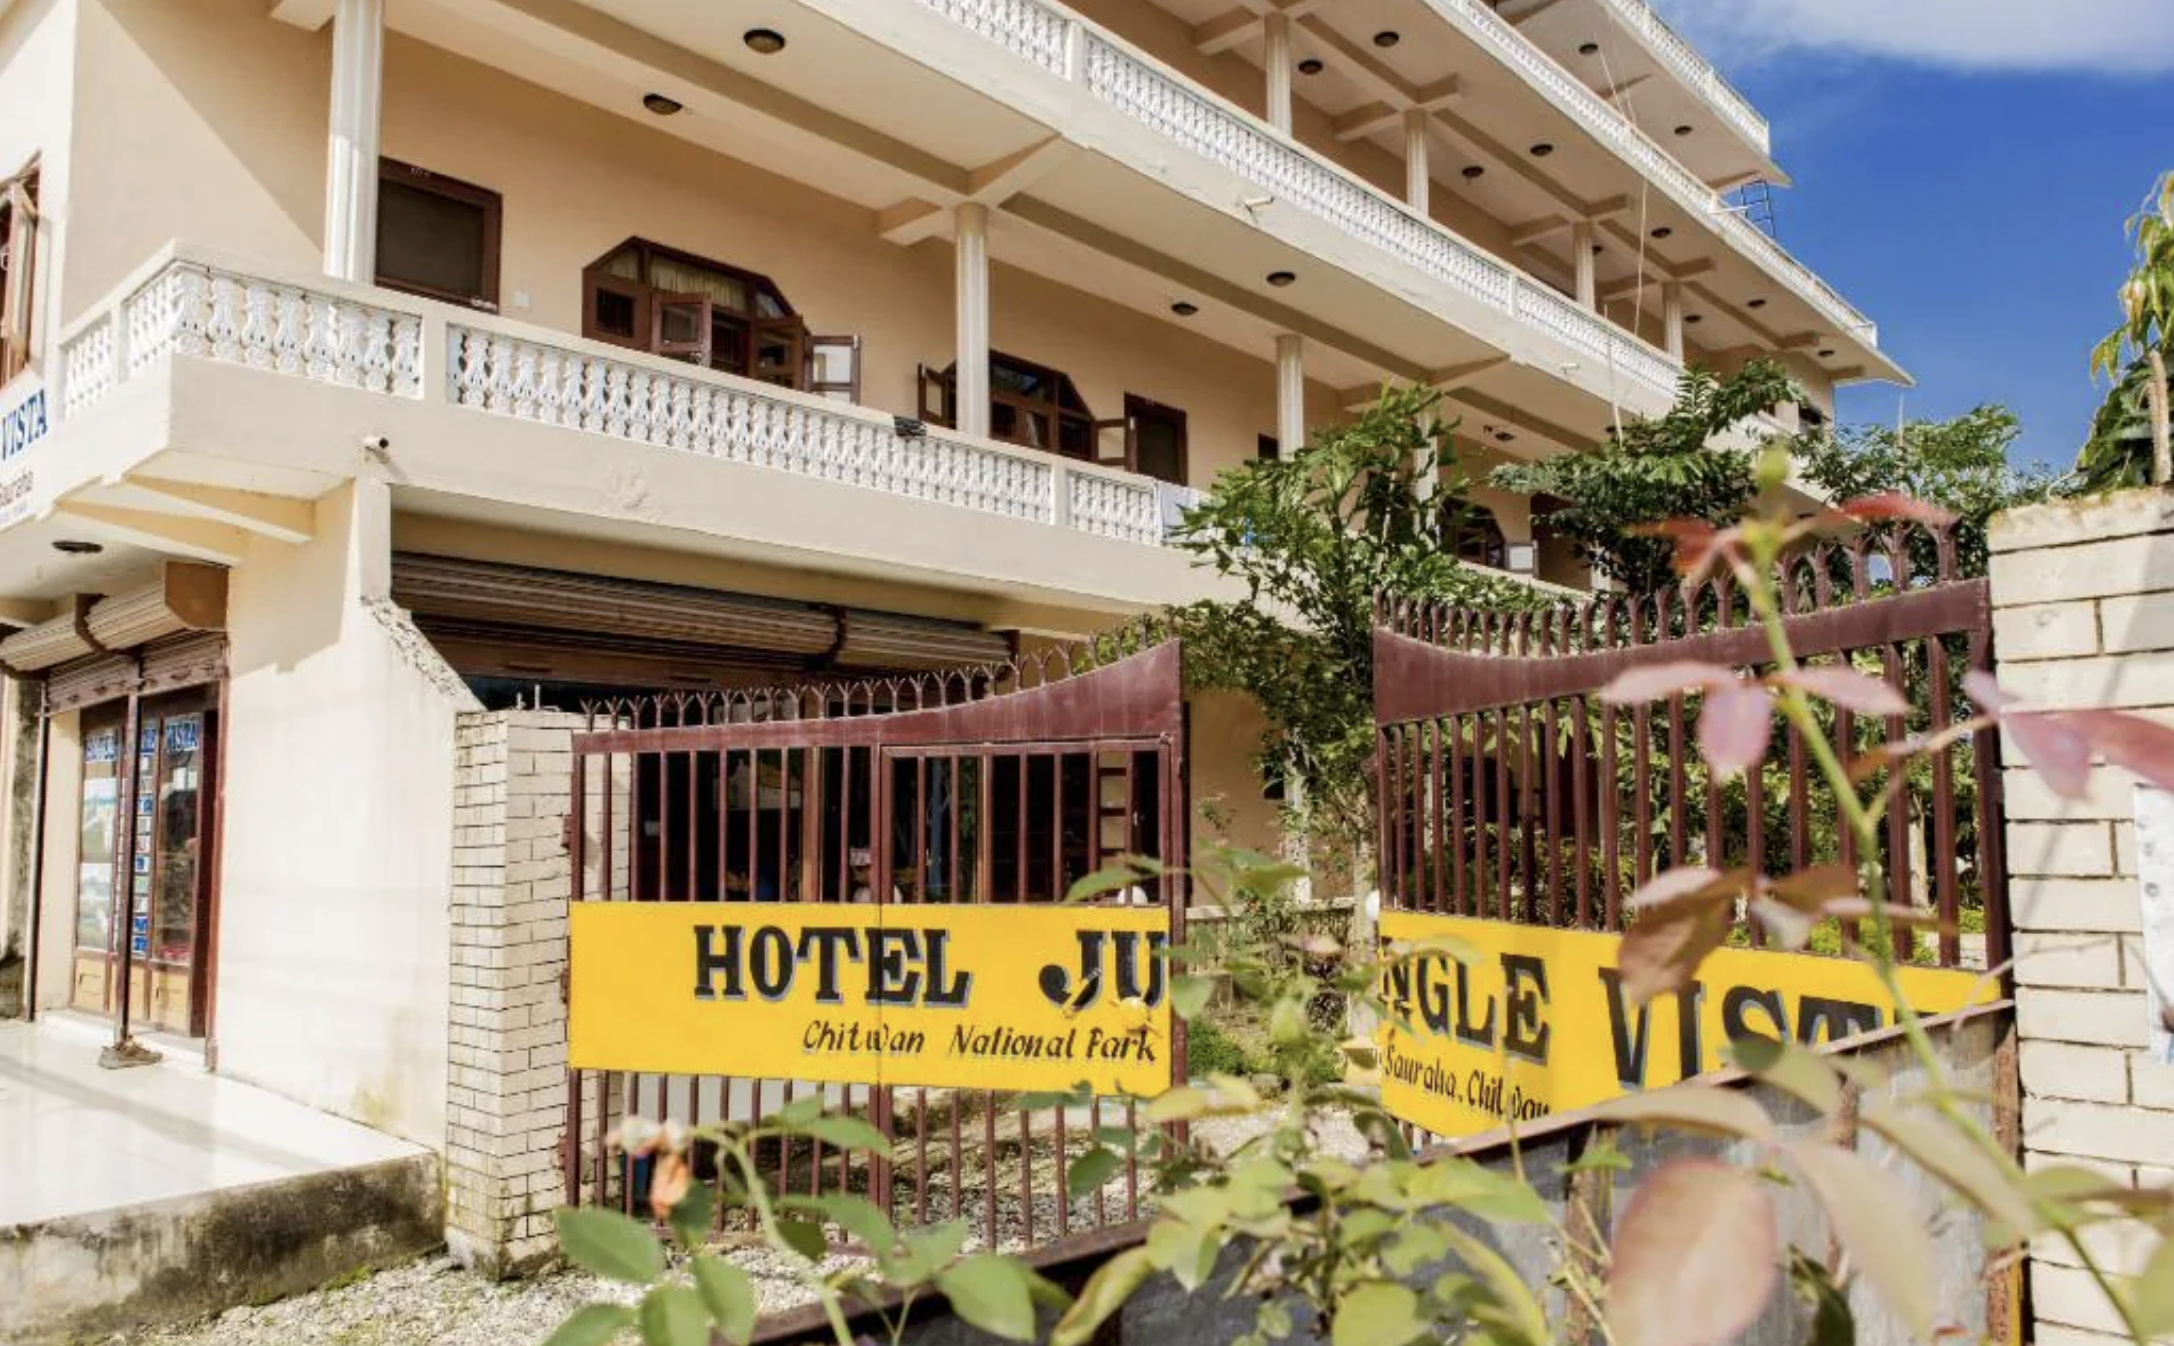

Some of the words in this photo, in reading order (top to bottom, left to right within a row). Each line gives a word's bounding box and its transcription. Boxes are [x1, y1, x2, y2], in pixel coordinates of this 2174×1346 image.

[2, 388, 48, 461] VISTA
[693, 924, 974, 1008] HOTEL
[802, 1018, 926, 1054] Chitwan
[949, 1023, 1077, 1059] National
[1084, 1026, 1158, 1064] Park
